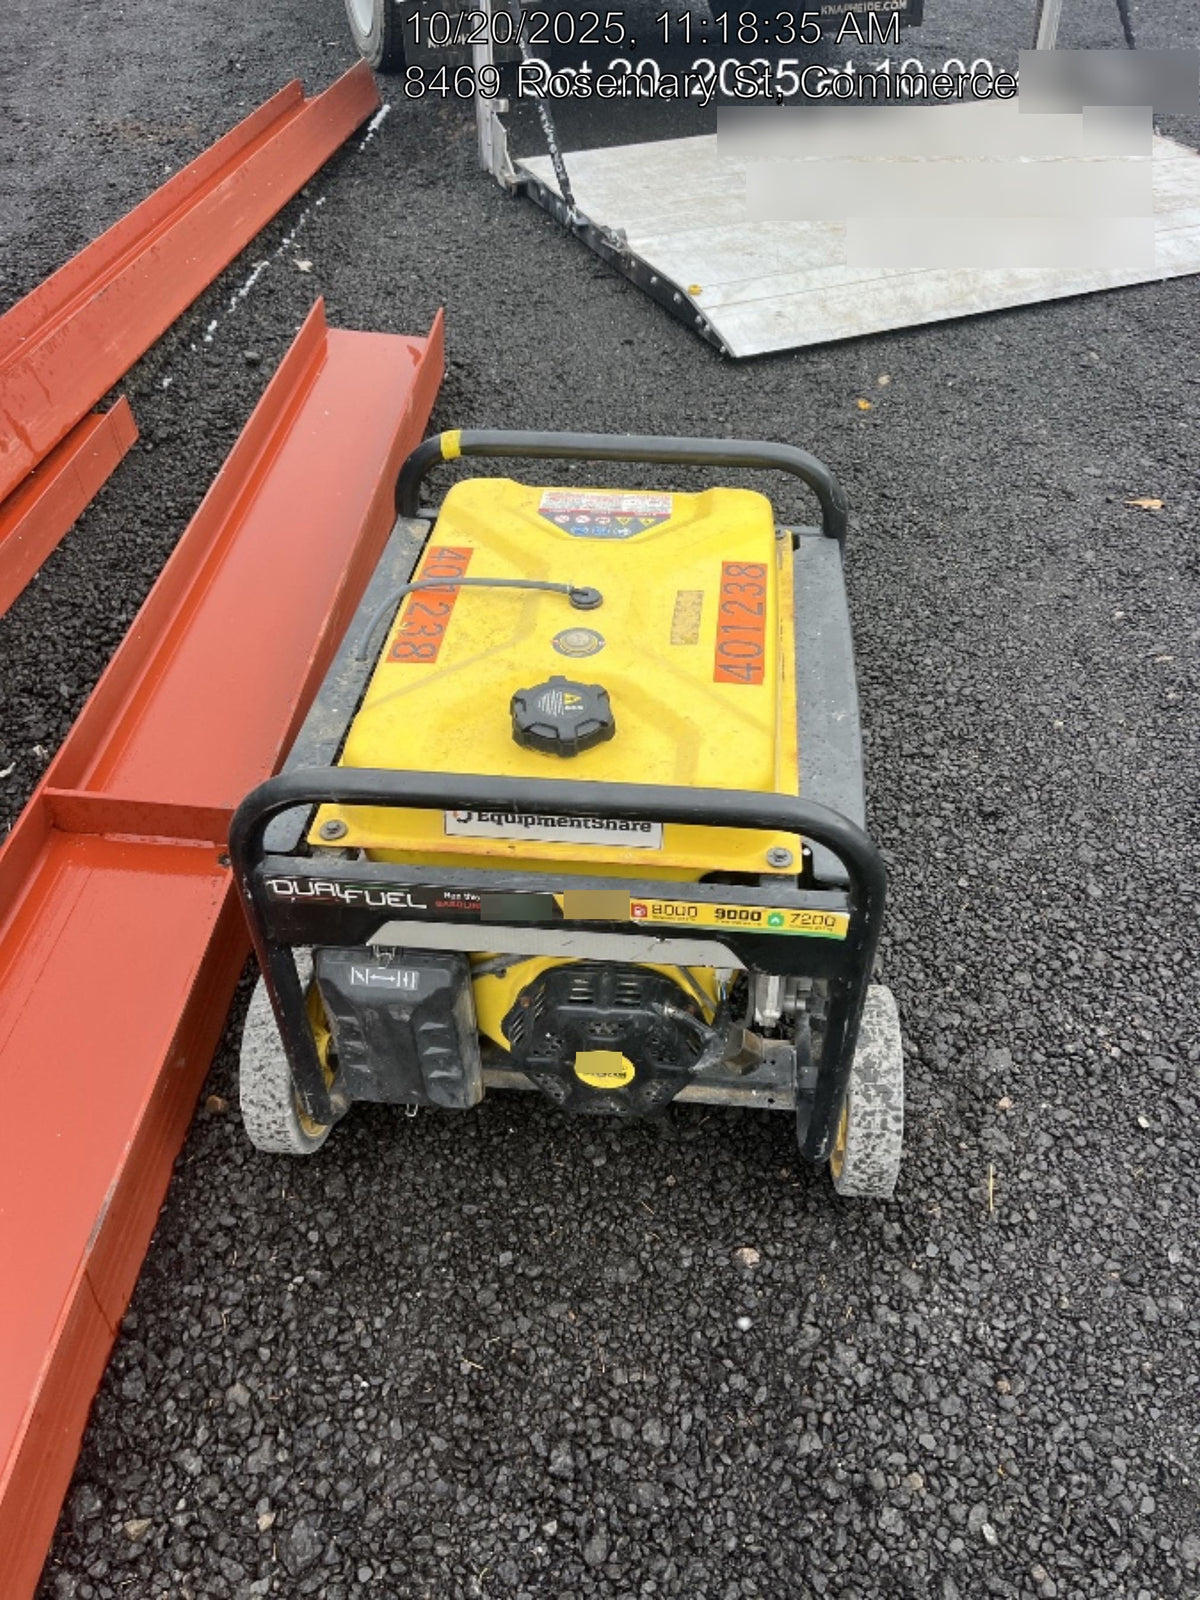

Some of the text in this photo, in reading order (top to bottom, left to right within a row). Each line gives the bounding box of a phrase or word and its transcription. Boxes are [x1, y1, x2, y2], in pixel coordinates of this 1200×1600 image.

[717, 564, 766, 682] 401238
[478, 810, 652, 833] EquipmentShare
[651, 904, 837, 927] 8000 9000 7200
